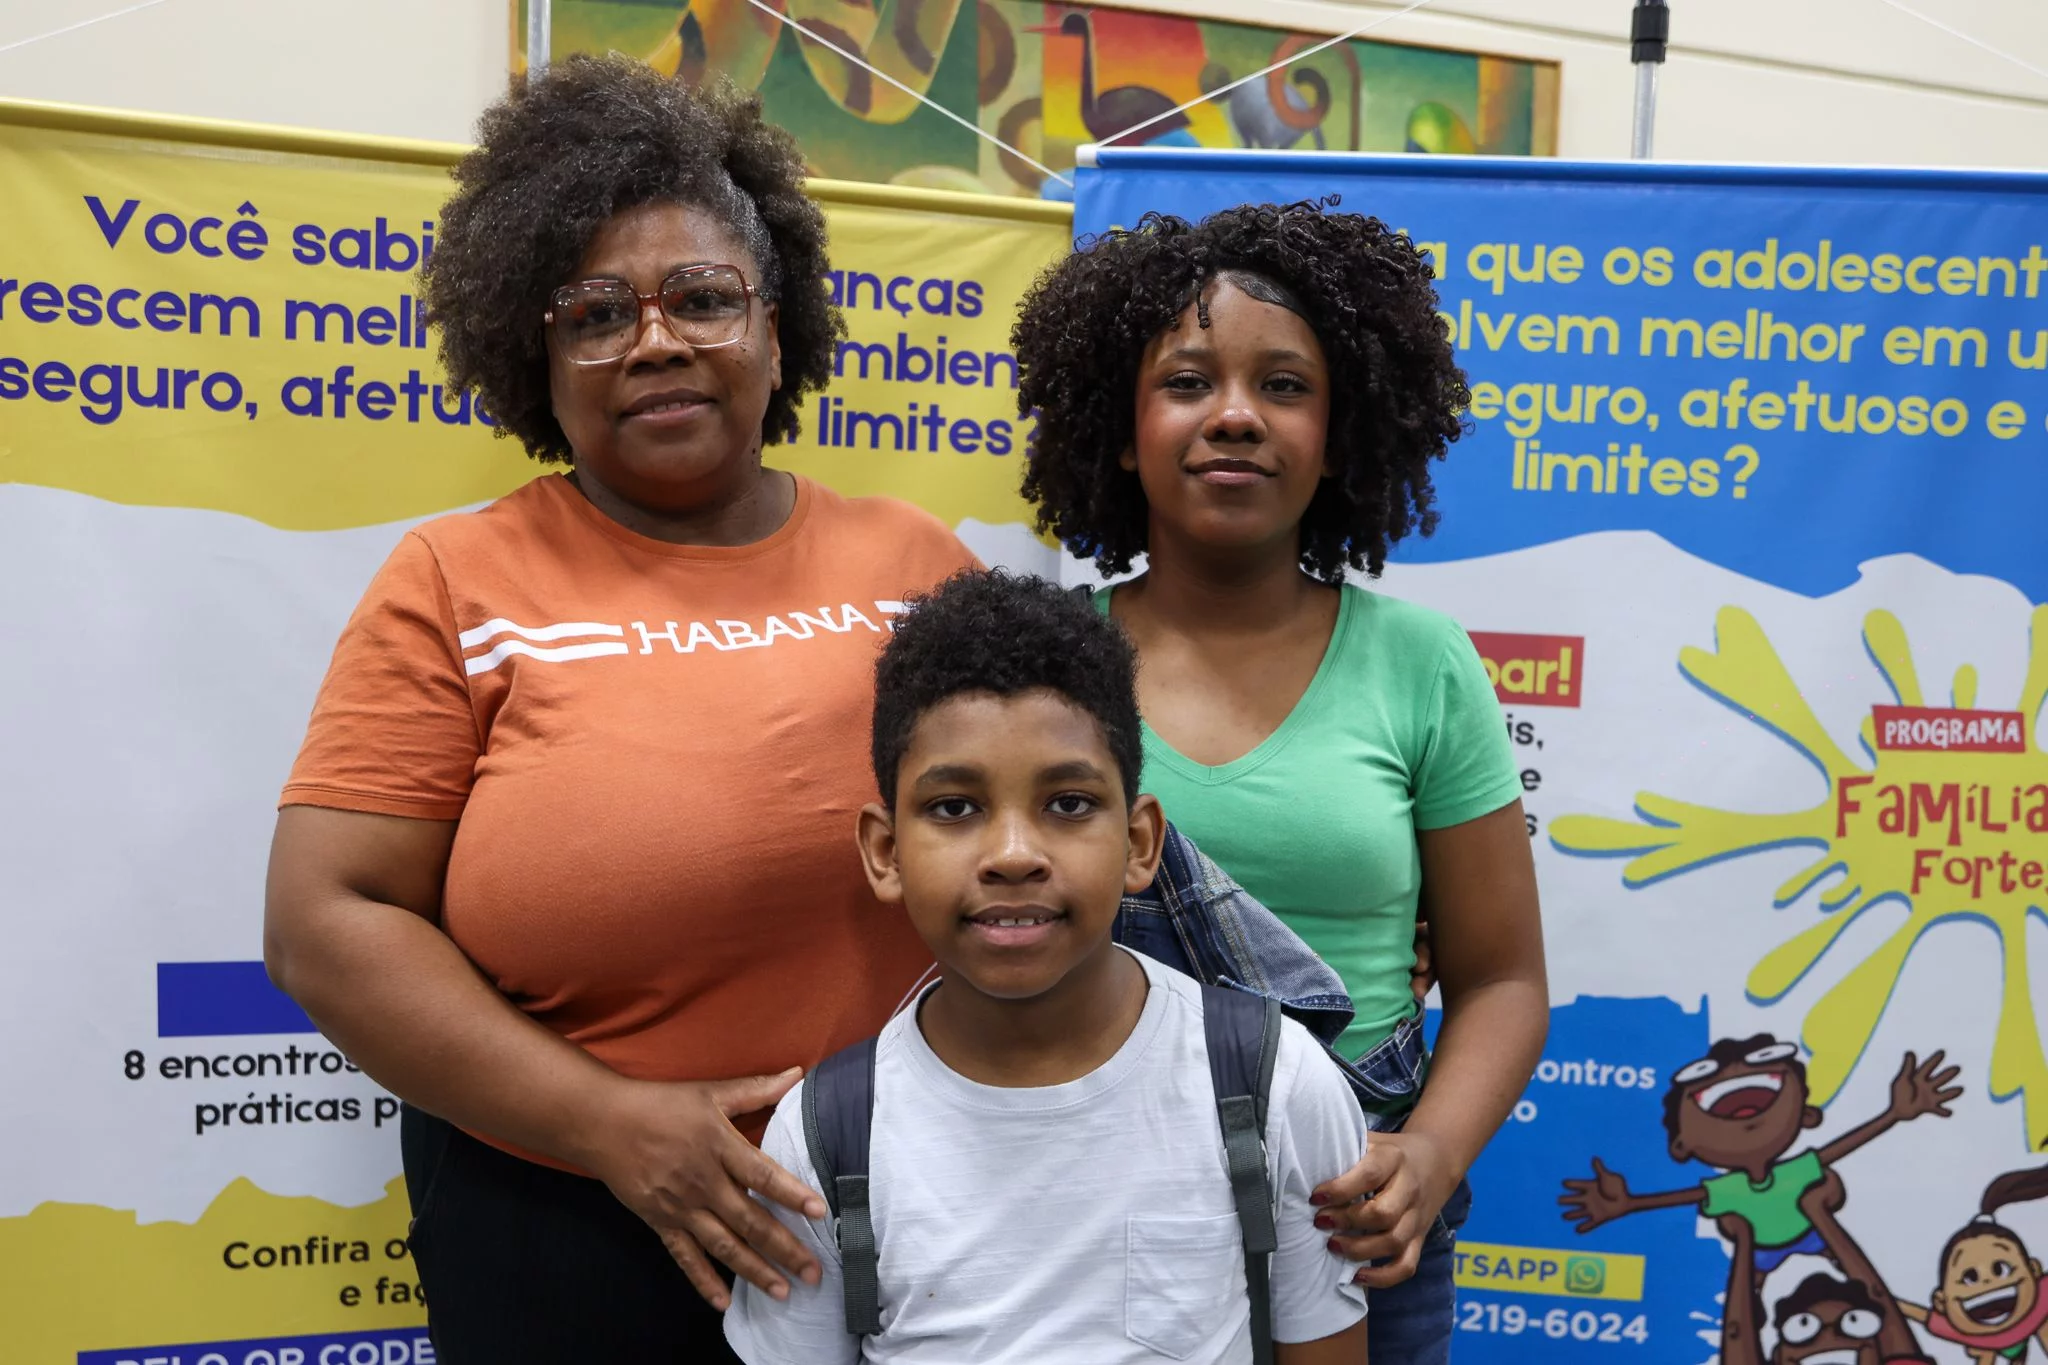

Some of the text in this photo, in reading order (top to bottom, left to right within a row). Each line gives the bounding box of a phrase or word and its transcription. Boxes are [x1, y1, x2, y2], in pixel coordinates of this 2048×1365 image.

[83, 195, 268, 261] Você
[1467, 242, 1584, 295] que
[1602, 246, 1674, 286] os
[1692, 238, 2048, 298] adolescent
[834, 333, 1018, 389] mbien
[1639, 307, 1866, 364] melhor
[1882, 325, 1988, 368] em
[0, 357, 258, 426] seguro,
[1454, 380, 1660, 439] eguro,
[1679, 377, 1968, 438] afetuoso
[1986, 400, 2027, 440] e
[1511, 440, 1760, 499] limites?
[631, 602, 880, 656] HABANA
[1884, 717, 2021, 749] PROGRAMA
[1910, 849, 2048, 899] Forte
[123, 1050, 146, 1080] 8
[1531, 1058, 1656, 1089] ontros
[195, 1092, 402, 1135] práticas p
[223, 1236, 370, 1270] Confira
[339, 1284, 361, 1307] e
[1453, 1301, 1649, 1344] 219-6024
